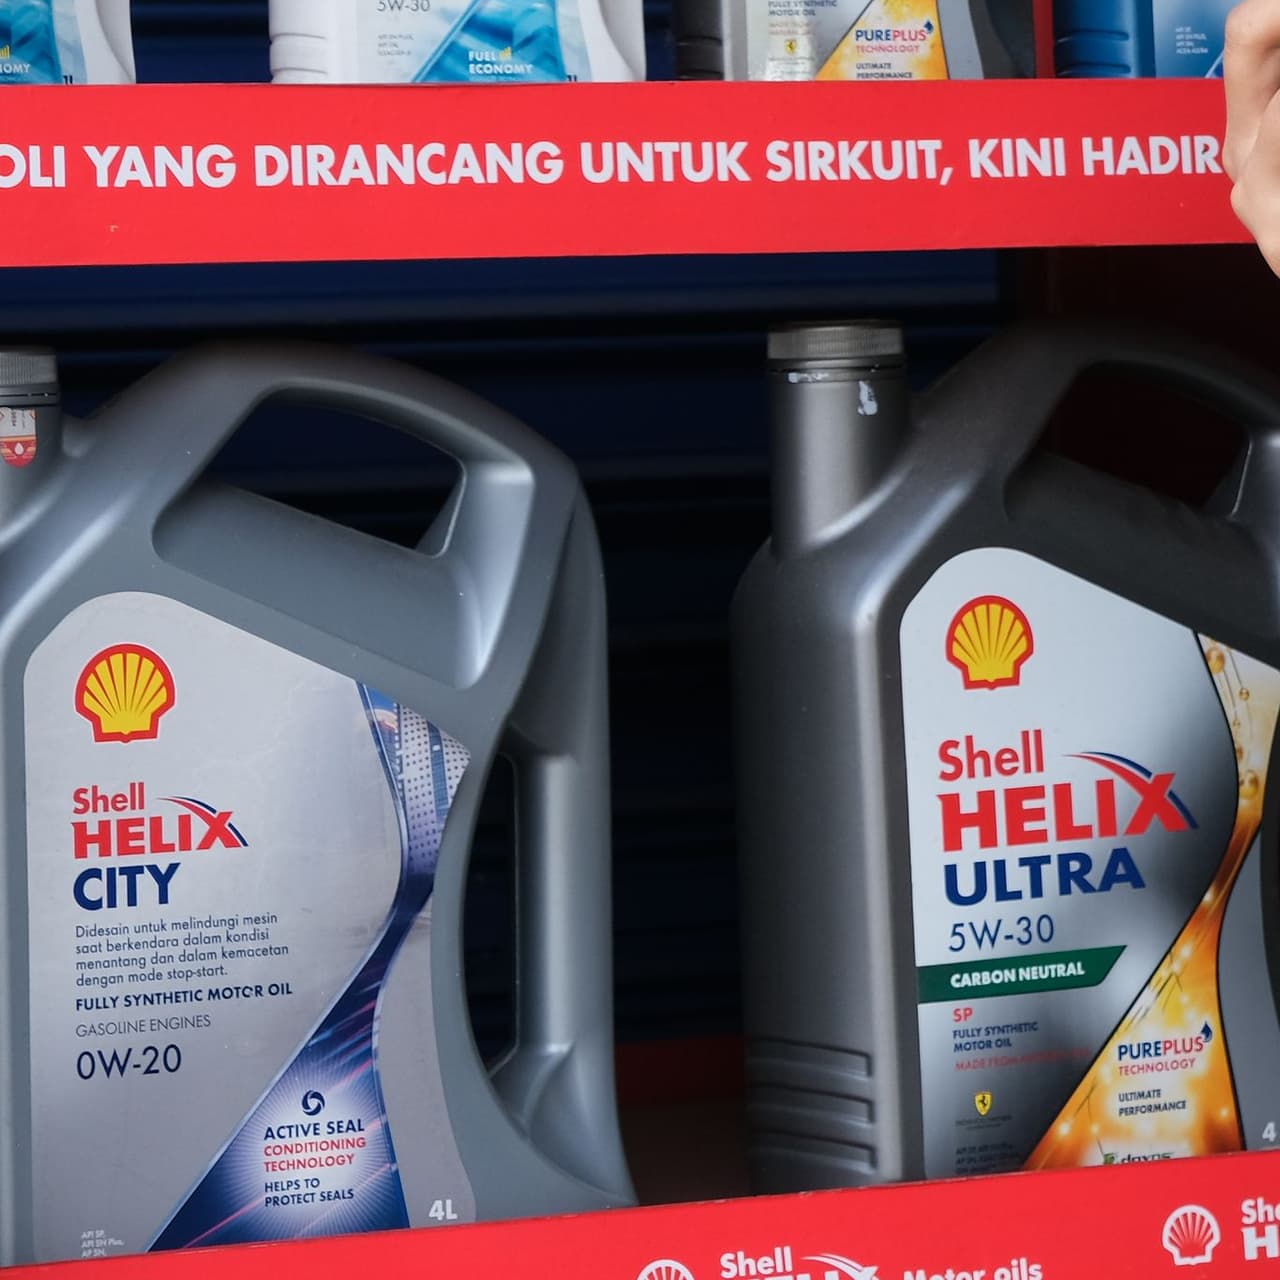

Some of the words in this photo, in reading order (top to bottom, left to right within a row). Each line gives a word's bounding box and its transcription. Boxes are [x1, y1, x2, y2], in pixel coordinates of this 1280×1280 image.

[856, 29, 927, 42] PUREPLUS
[469, 51, 496, 61] FUEL
[856, 44, 920, 54] TECHNOLOGY
[469, 64, 533, 74] ECONOMY
[0, 144, 65, 188] OLI
[83, 144, 236, 188] YANG
[254, 142, 563, 186] DIRANCANG
[581, 141, 750, 183] UNTUK
[766, 139, 952, 185] SIRKUIT,
[969, 137, 1066, 177] KINI
[1082, 135, 1224, 175] HADIR
[938, 729, 1044, 782] Shell
[73, 782, 144, 815] Shell
[936, 764, 1199, 852] HELIX
[71, 803, 248, 859] HELIX
[73, 862, 181, 911] CITY
[944, 847, 1146, 906] ULTRA
[75, 924, 130, 938] Didesain
[134, 920, 167, 934] untuk
[171, 914, 239, 930] melindungi
[243, 912, 278, 926] mesin
[948, 914, 1055, 952] 5W-30
[75, 942, 102, 955] saat
[106, 936, 179, 952] berkendara
[183, 931, 222, 946] dalam
[226, 928, 269, 942] kondisi
[75, 955, 146, 970] menantang
[150, 952, 174, 965] dan
[178, 948, 217, 962] dalam
[221, 945, 289, 959] kemacetan
[75, 973, 124, 988] dengan
[128, 969, 163, 983] mode
[167, 965, 228, 981] stop-start.
[951, 969, 1016, 988] CARBON
[1018, 961, 1086, 981] NEUTRAL
[75, 996, 119, 1011] FULLY
[124, 989, 202, 1007] SYNTHETIC
[207, 985, 264, 1001] MOTOR
[268, 983, 293, 995] OIL
[953, 1007, 973, 1022] SP
[75, 1018, 146, 1037] GASOLINE
[150, 1015, 211, 1031] ENGINES
[953, 1026, 981, 1039] FULLY
[984, 1021, 1039, 1037] SYNTHETIC
[953, 1039, 992, 1052] MOTOR
[994, 1037, 1012, 1048] OIL
[1118, 1036, 1204, 1061] PUREPLUS
[76, 1044, 182, 1080] 0W-20
[1118, 1058, 1195, 1076] TECHNOLOGY
[1118, 1089, 1161, 1102] ULTIMATE
[1118, 1100, 1186, 1117] PERFORMANCE
[264, 1122, 320, 1140] ACTIVE
[326, 1119, 365, 1134] SEAL
[264, 1137, 366, 1156] CONDITIONING
[264, 1154, 354, 1172] TECHNOLOGY
[265, 1179, 300, 1192] HELPS
[304, 1178, 320, 1189] TO
[264, 1193, 316, 1207] PROTECT
[320, 1189, 354, 1201] SEALS
[428, 1199, 458, 1220] 4L
[720, 1246, 792, 1279] Shell
